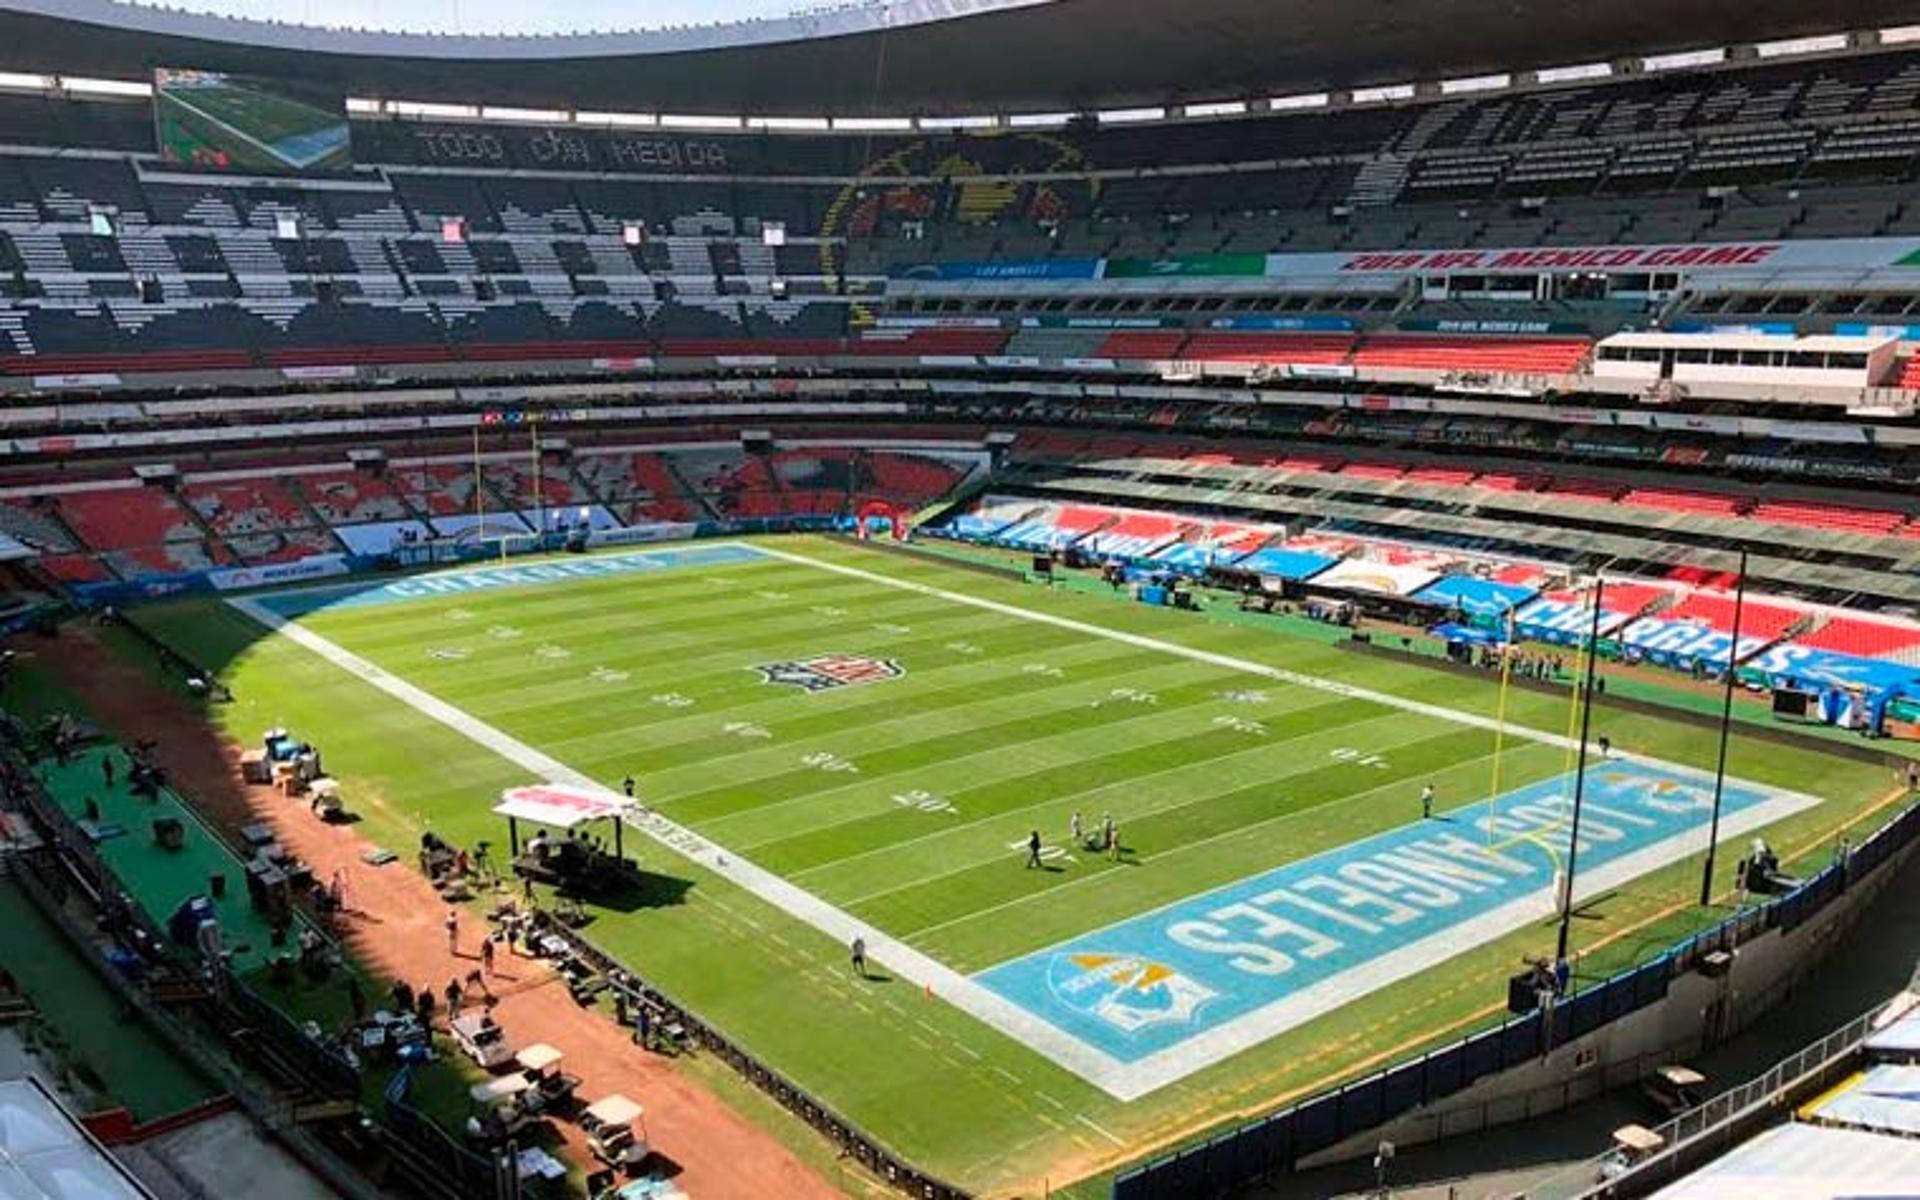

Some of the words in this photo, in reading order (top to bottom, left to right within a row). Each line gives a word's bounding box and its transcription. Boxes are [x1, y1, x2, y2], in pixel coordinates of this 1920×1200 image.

[1341, 254, 1421, 270] 2019
[1422, 251, 1485, 269] NFL
[1487, 248, 1634, 269] MEXICO
[1636, 244, 1785, 267] GAME
[1474, 794, 1656, 854] LOS
[1166, 832, 1537, 976] ANGELES
